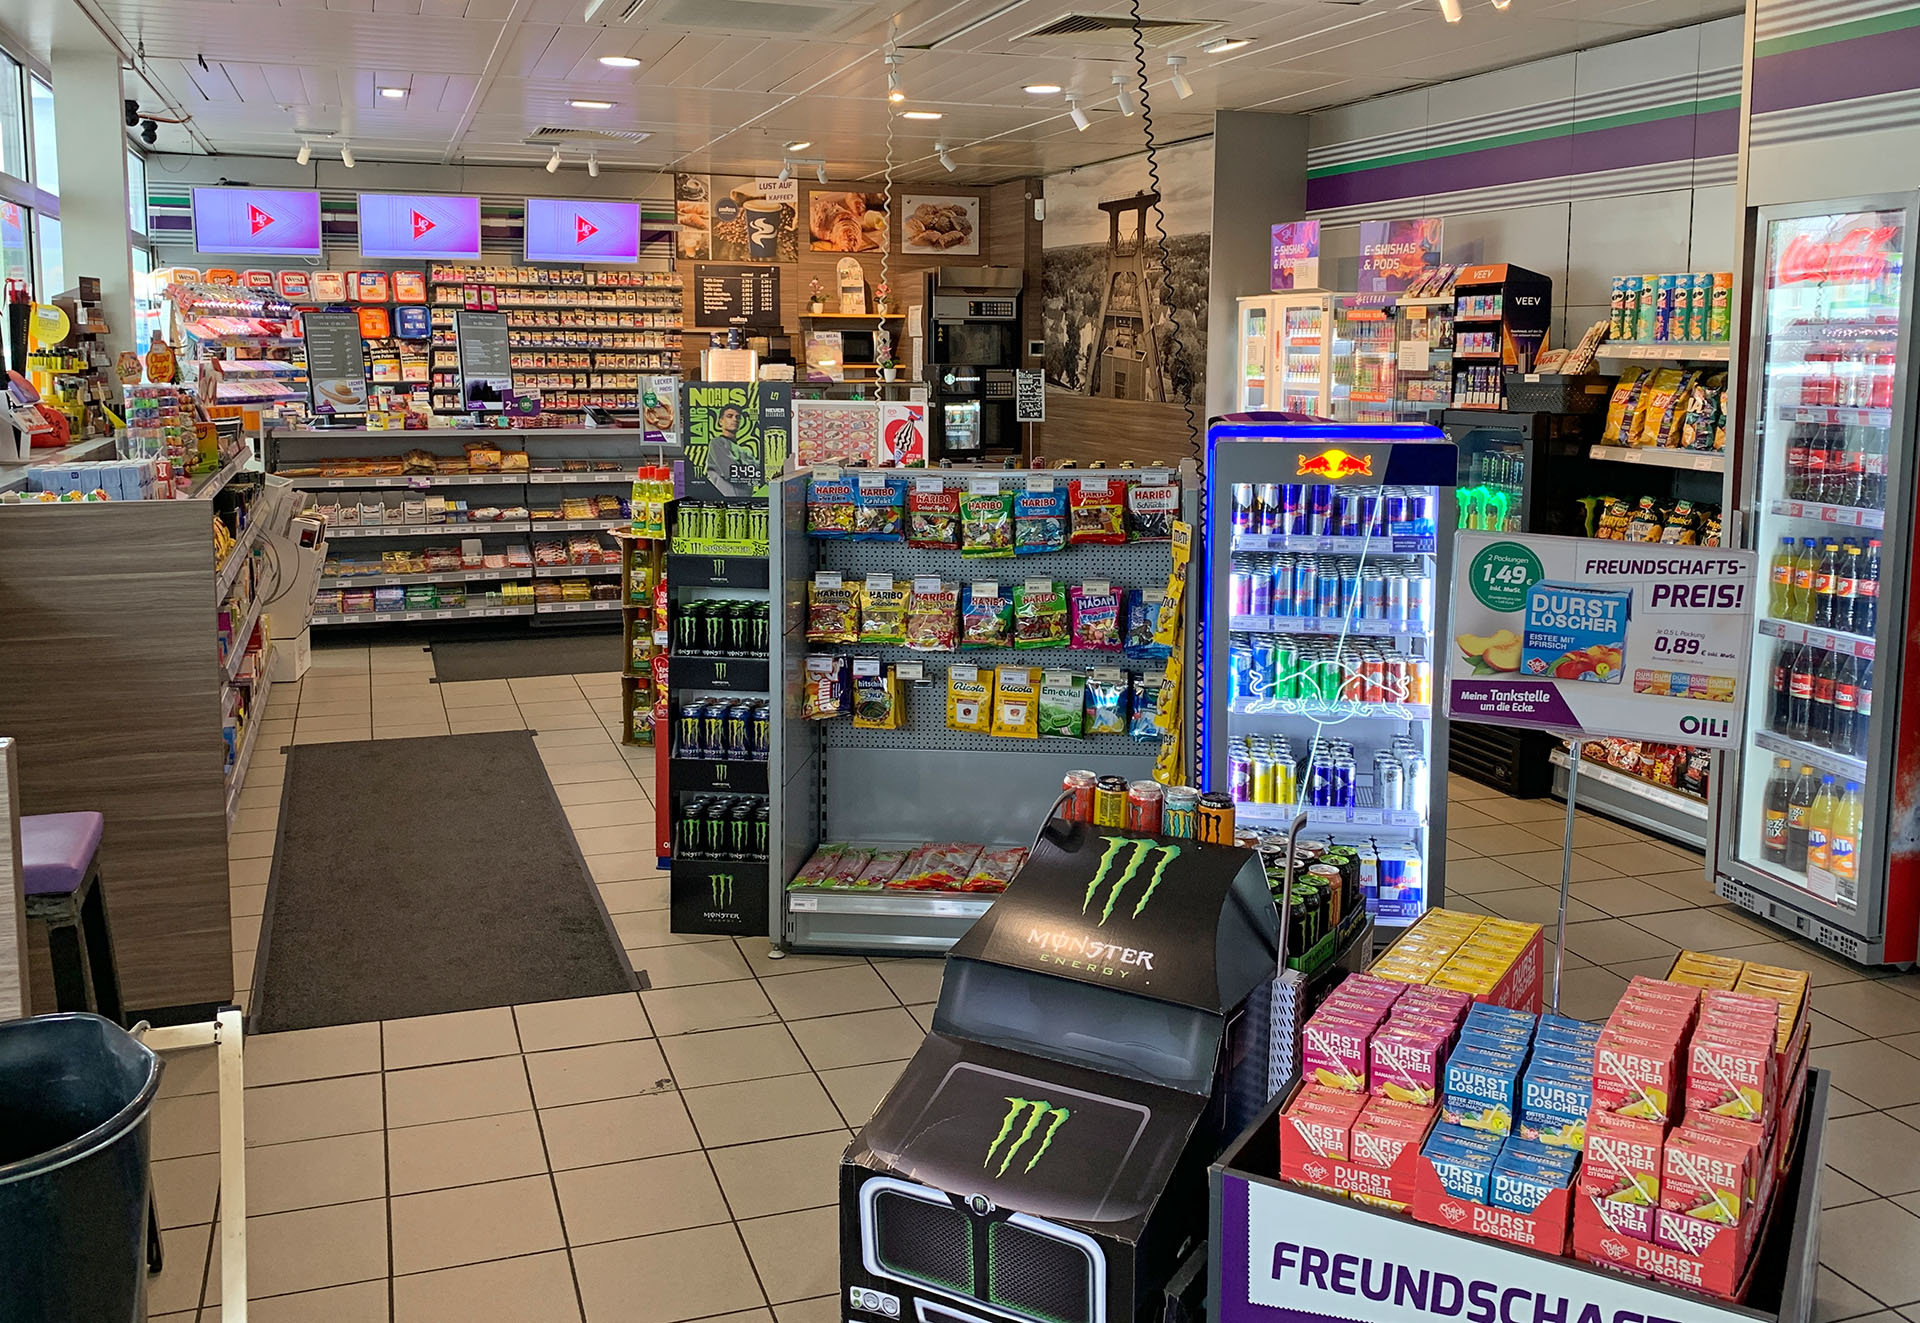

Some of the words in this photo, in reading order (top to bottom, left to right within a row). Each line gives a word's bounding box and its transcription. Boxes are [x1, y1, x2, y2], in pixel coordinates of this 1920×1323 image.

[1274, 244, 1305, 256] E-SHISHAS
[1364, 243, 1416, 256] E-SHISHAS
[1273, 259, 1279, 269] &
[1364, 260, 1371, 270] &
[1373, 258, 1400, 270] PODS
[1473, 269, 1494, 279] VEEV
[1515, 297, 1541, 305] VEEV
[815, 486, 850, 495] HARIBO
[860, 488, 895, 496] HARIBO
[1134, 490, 1172, 500] HARIBO
[917, 495, 951, 504] HARIBO
[968, 500, 1004, 511] HARIBO
[1021, 498, 1056, 507] HARIBO
[1494, 555, 1529, 564] Packungen
[1585, 560, 1747, 575] FREUNDSCHAFTS-
[1483, 564, 1527, 585] 1,49
[817, 590, 850, 598] HARIBO
[869, 591, 903, 599] HARIBO
[915, 593, 954, 601] HARIBO
[1022, 593, 1057, 603] HARIBO
[1651, 584, 1745, 608] PREIS!
[1079, 596, 1116, 610] MAOAM
[1532, 594, 1619, 619] DURST
[1531, 612, 1618, 633] LÖSCHER
[1529, 633, 1558, 643] EISTEE
[1560, 636, 1575, 644] MIT
[1680, 631, 1705, 639] Packung
[1529, 640, 1567, 650] PFIRSICH
[1654, 636, 1700, 655] 0,89
[953, 681, 985, 693] Ricola
[1042, 686, 1081, 698] Em-eukal
[1461, 691, 1488, 701] Meine
[1490, 689, 1550, 702] Tankstelle
[1480, 704, 1495, 712] um
[1496, 702, 1510, 712] die
[1512, 702, 1536, 712] Ecke.
[1679, 716, 1729, 738] OIL!
[703, 911, 740, 920] MONSTER
[1027, 928, 1154, 971] MONSTER
[1040, 953, 1129, 978] ENERGY
[1450, 1069, 1509, 1093] DURST
[1448, 1081, 1508, 1102] LÖSCHER
[1597, 1085, 1624, 1094] ZITRONE
[1691, 1083, 1719, 1094] ZITRONE
[1528, 1084, 1589, 1107] DURST
[1526, 1096, 1588, 1117] LÖSCHER
[1335, 1166, 1392, 1188] DURST
[1587, 1172, 1615, 1181] ZITRONE
[1334, 1178, 1392, 1199] LÖSCHER
[1442, 1178, 1483, 1198] SCHER
[1666, 1184, 1695, 1195] ZITRONE
[1495, 1190, 1542, 1209] LÖSCH
[1599, 1198, 1649, 1217] URST
[1473, 1208, 1536, 1233] DURST
[1473, 1222, 1535, 1245] LÖSCHER
[1636, 1246, 1704, 1276] DURST
[1636, 1258, 1702, 1287] LÖSCHER
